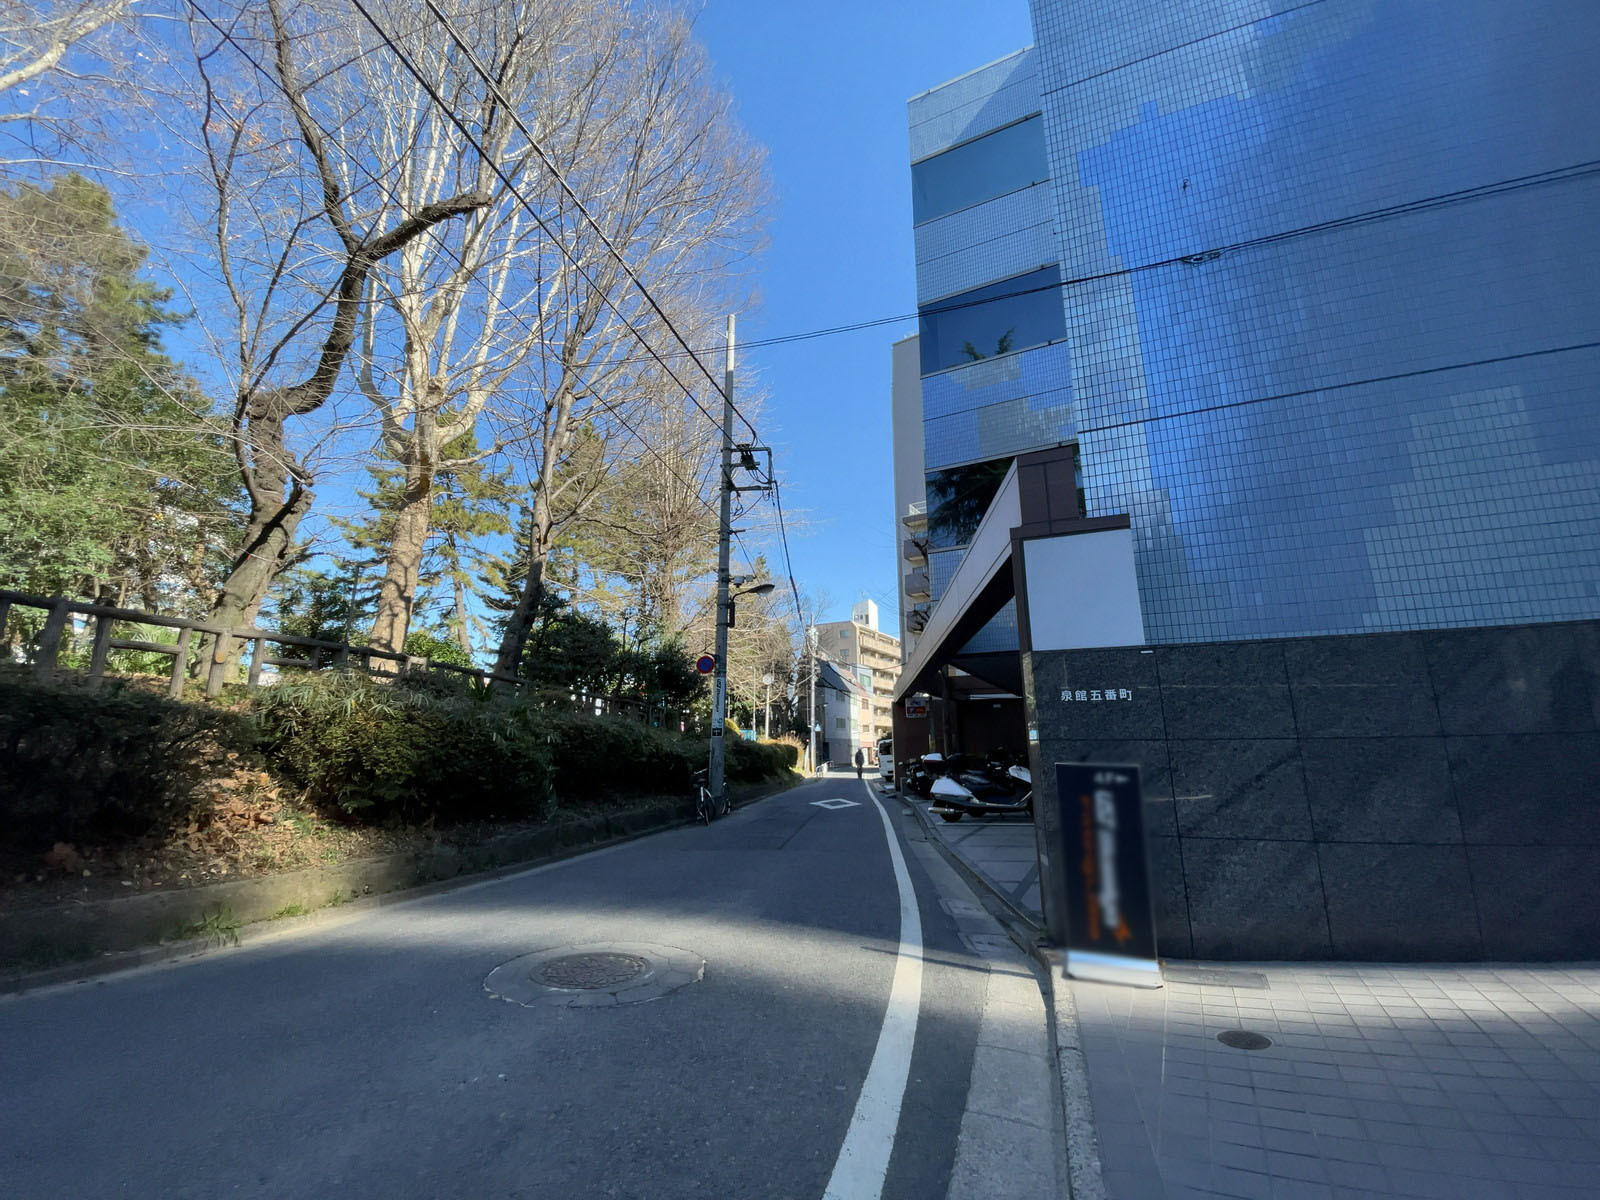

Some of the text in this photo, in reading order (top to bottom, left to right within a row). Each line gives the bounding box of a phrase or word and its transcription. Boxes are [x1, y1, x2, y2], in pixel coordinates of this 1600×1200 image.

[1061, 688, 1133, 702] 泉館五番町
